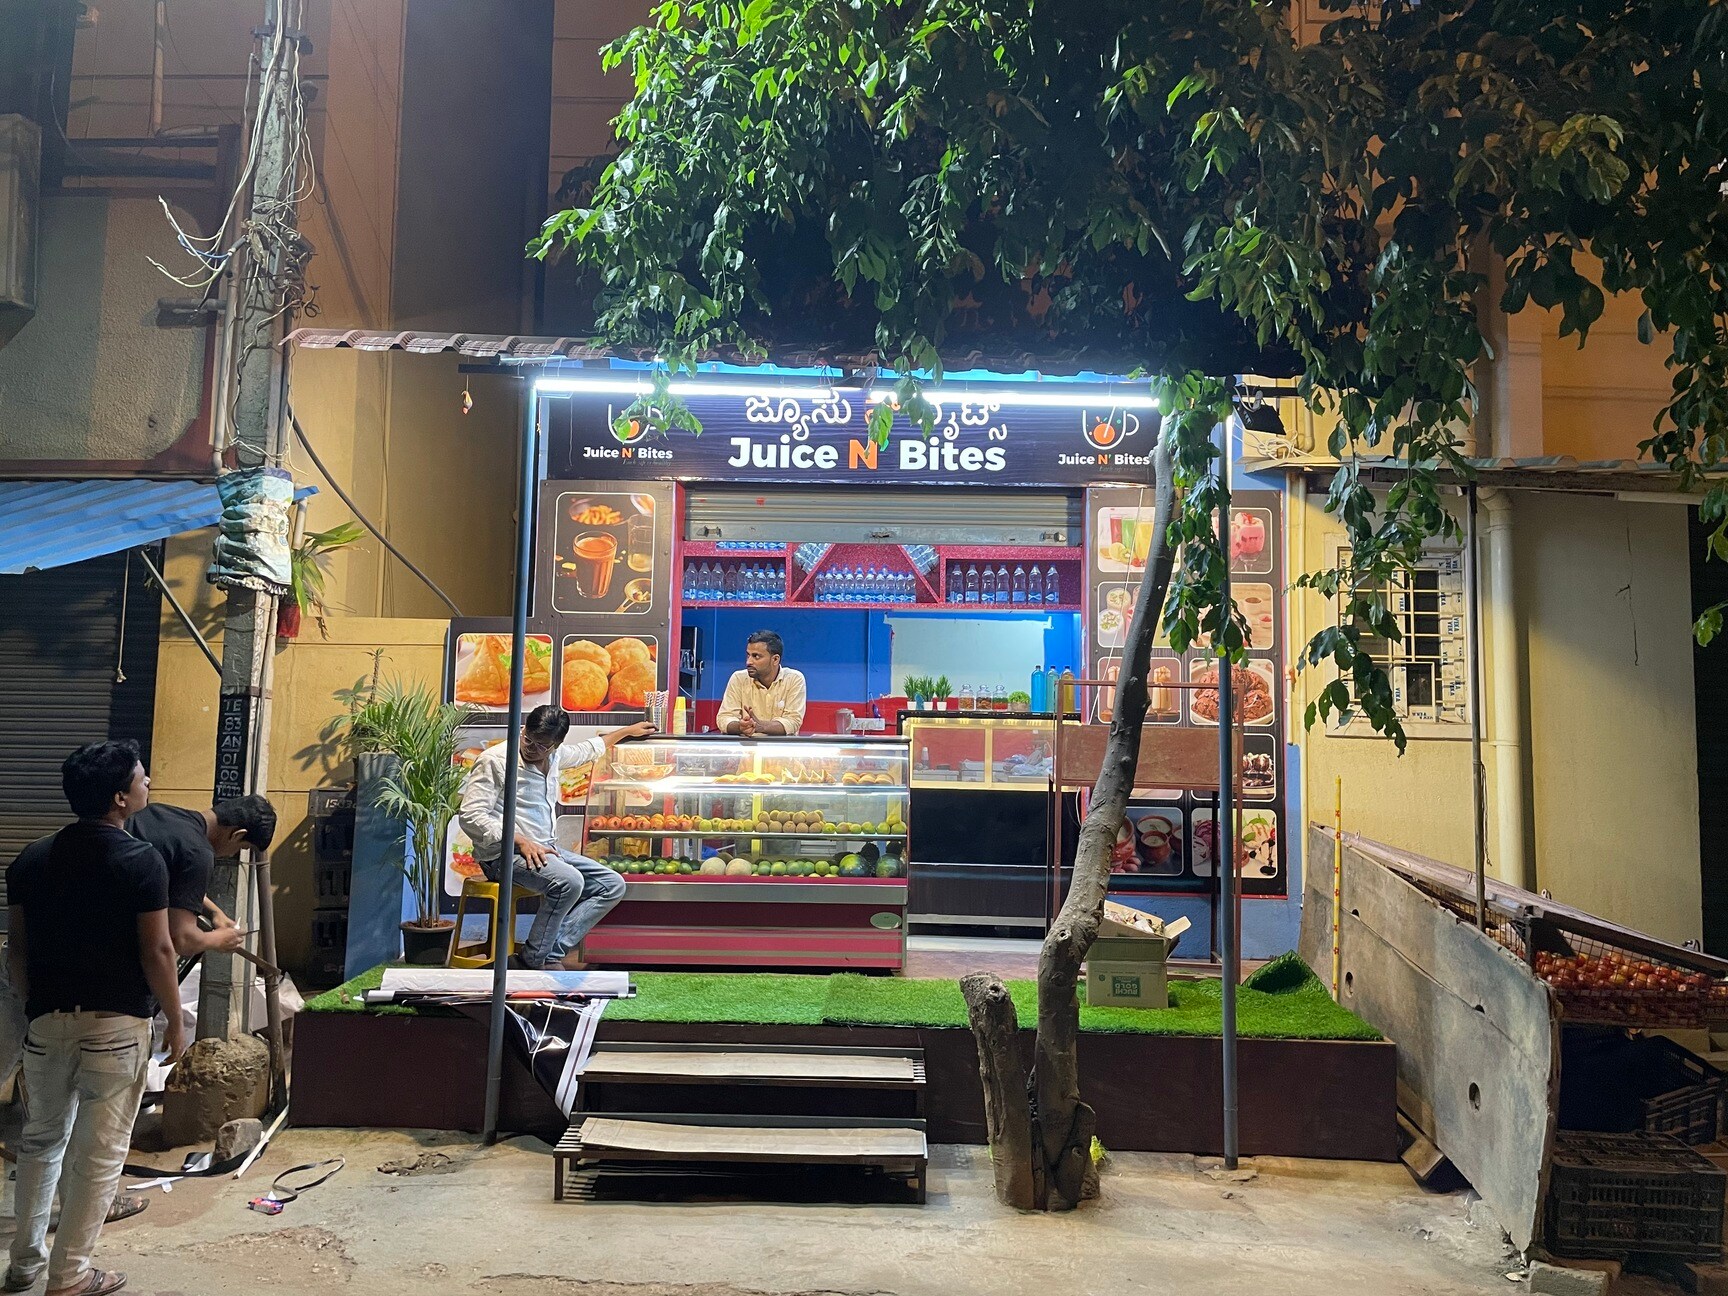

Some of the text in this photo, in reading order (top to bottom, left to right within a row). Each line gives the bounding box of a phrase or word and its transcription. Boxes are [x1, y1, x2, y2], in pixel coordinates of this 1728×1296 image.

[583, 446, 620, 459] Juice
[637, 446, 673, 460] Bites
[727, 434, 839, 469] Juice
[899, 436, 1007, 471] Bites
[1058, 453, 1095, 465] Juice
[1114, 453, 1150, 465] Bites
[223, 699, 242, 712] TE
[221, 735, 242, 748] AN
